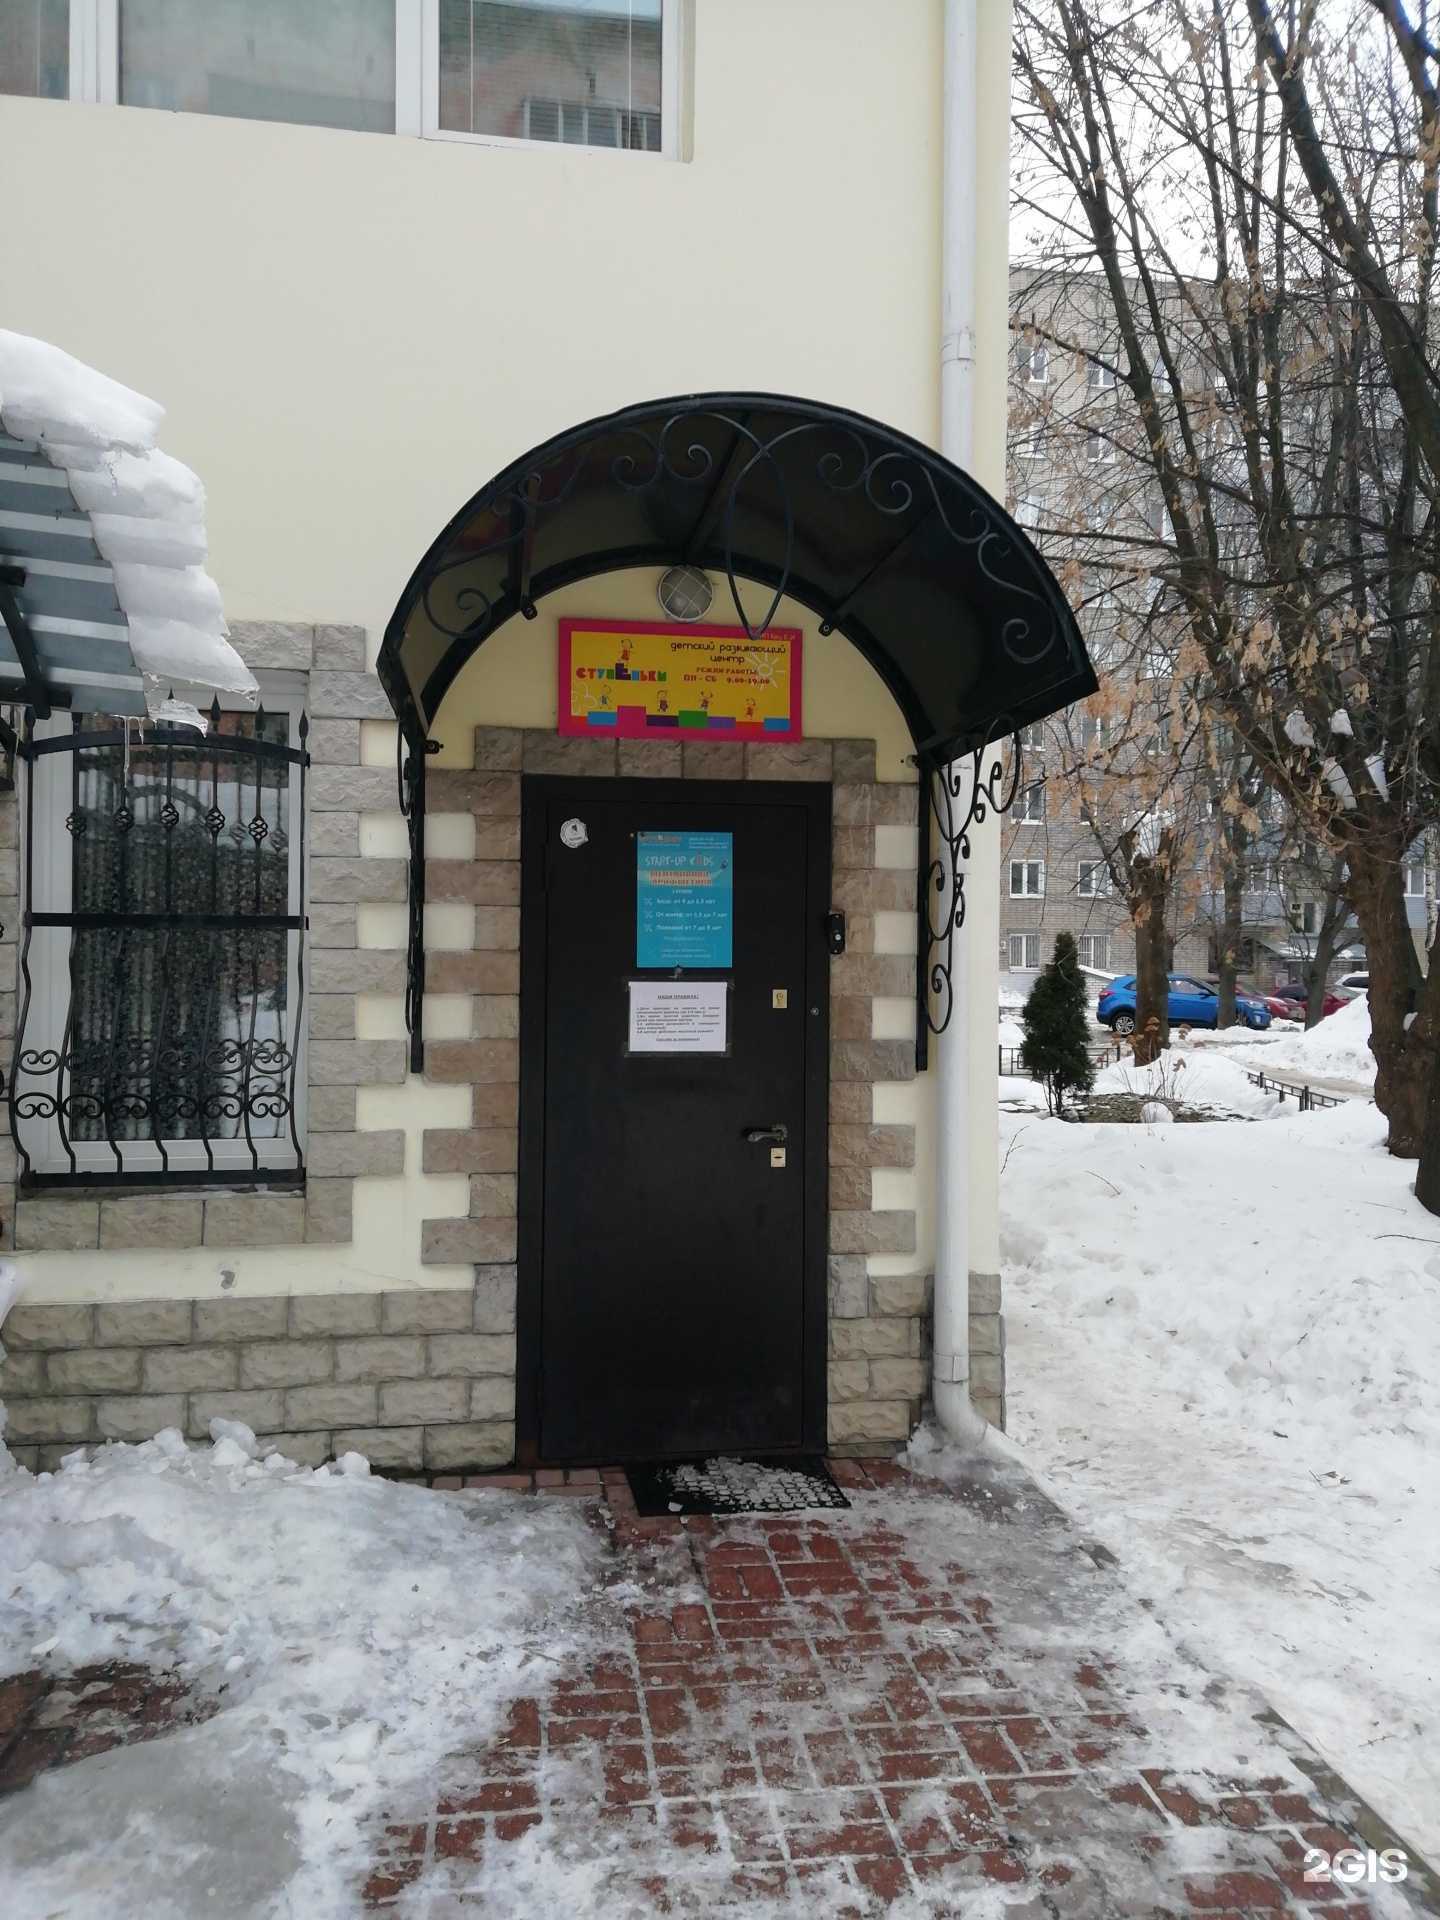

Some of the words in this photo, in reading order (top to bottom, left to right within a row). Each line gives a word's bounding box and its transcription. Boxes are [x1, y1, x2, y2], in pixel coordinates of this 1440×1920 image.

[671, 640, 715, 653] детский
[719, 643, 786, 655] развивающий
[710, 655, 745, 665] центр
